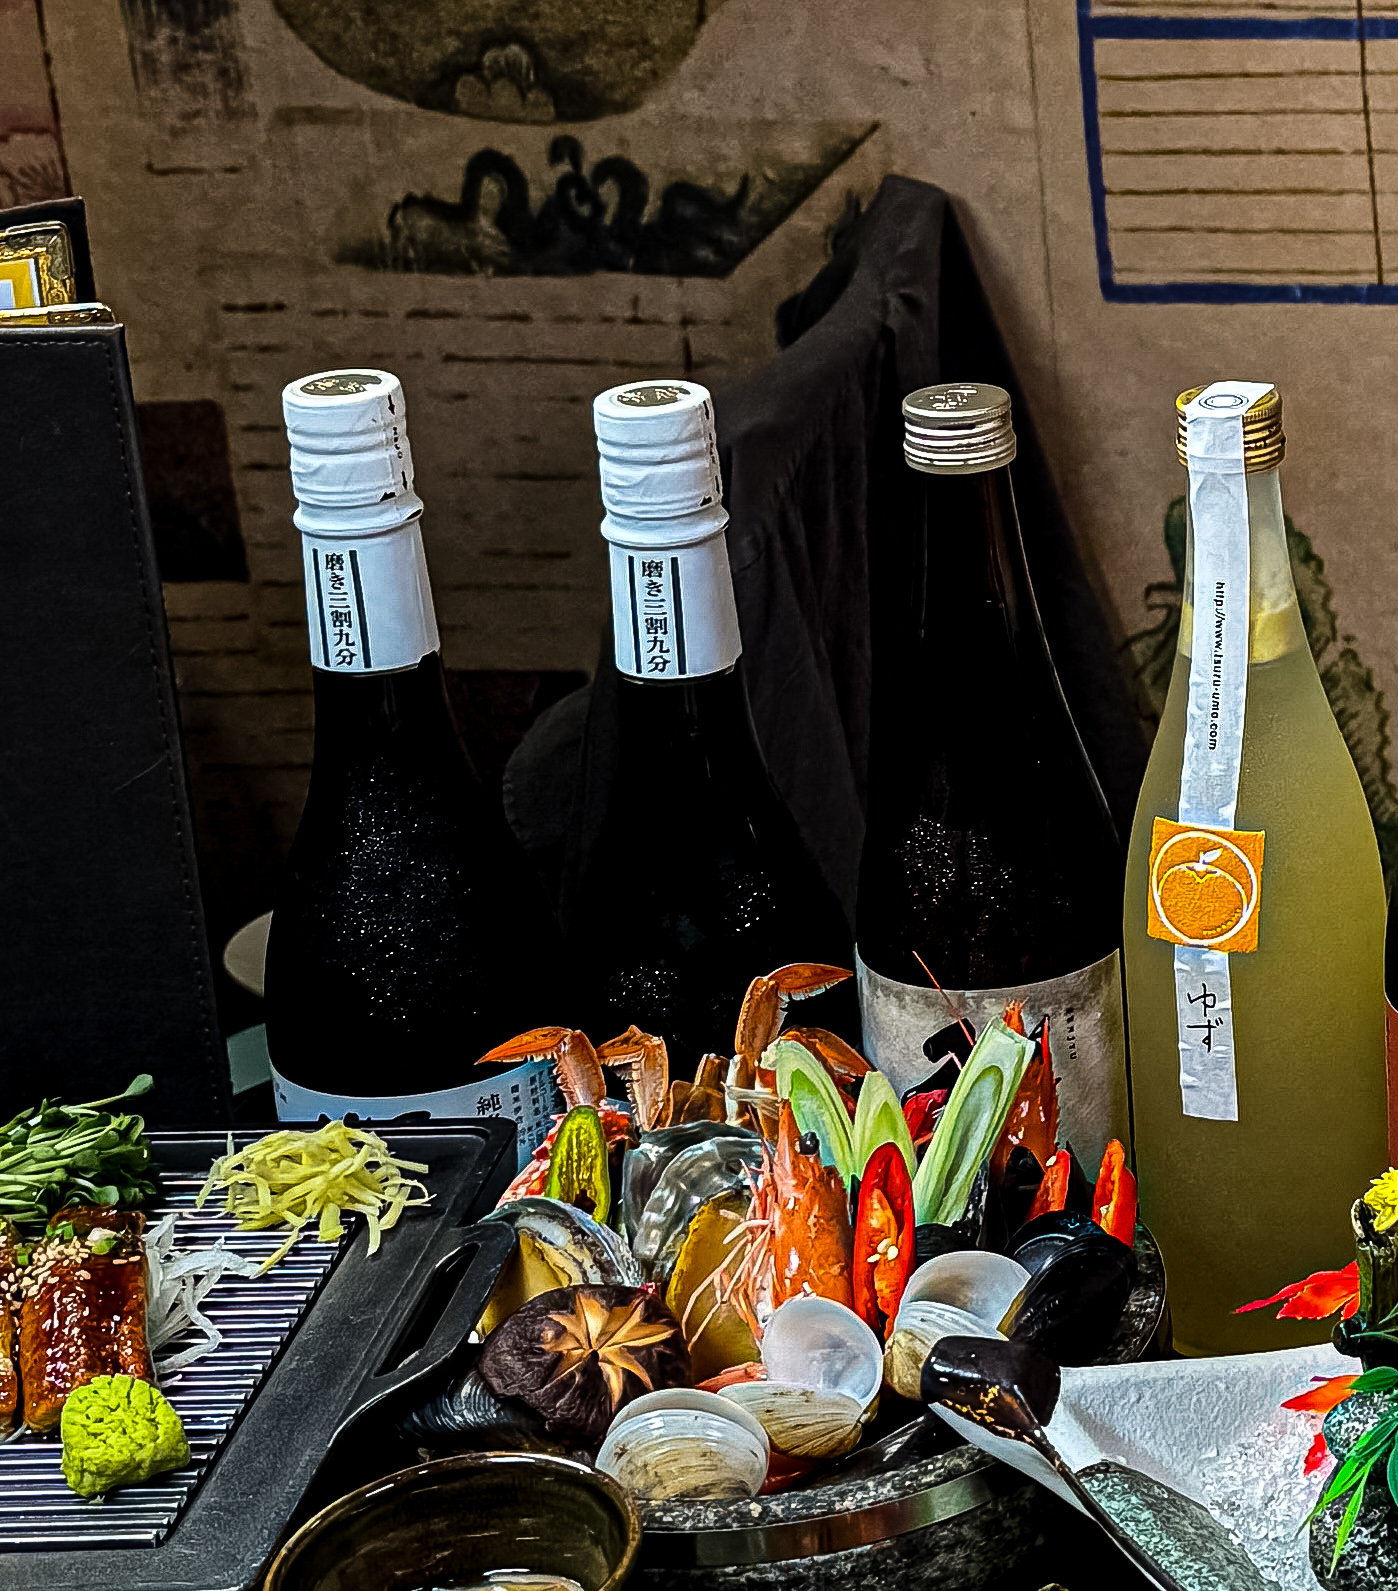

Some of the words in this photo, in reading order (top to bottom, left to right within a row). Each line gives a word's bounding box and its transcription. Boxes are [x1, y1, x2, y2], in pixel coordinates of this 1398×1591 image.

[325, 552, 358, 667] 磨き三割九分
[640, 559, 671, 674] 磨き三割九分
[1186, 982, 1225, 1053] ゆず
